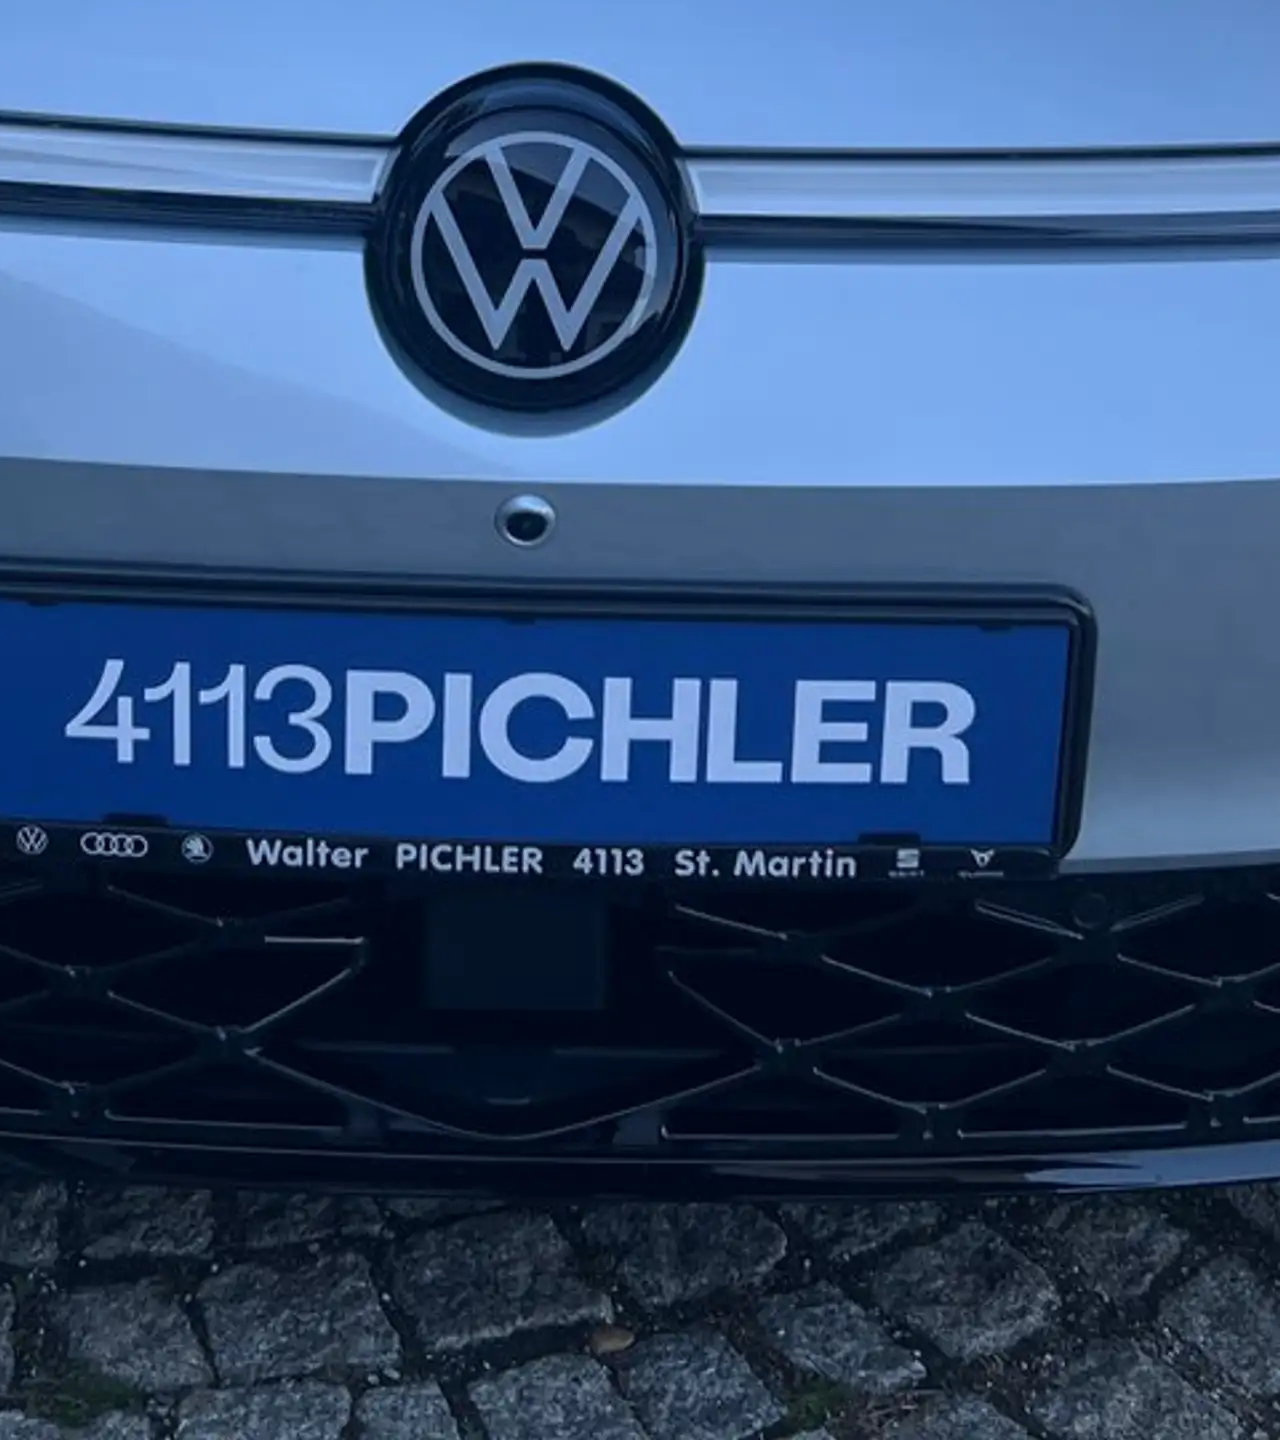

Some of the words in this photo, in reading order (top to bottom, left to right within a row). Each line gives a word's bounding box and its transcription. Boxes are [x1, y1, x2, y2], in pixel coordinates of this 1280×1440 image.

[246, 838, 368, 868] Walter
[395, 843, 544, 874] PICHLER
[573, 847, 644, 875] 4113
[674, 849, 719, 878] St.
[733, 849, 857, 879] Martin
